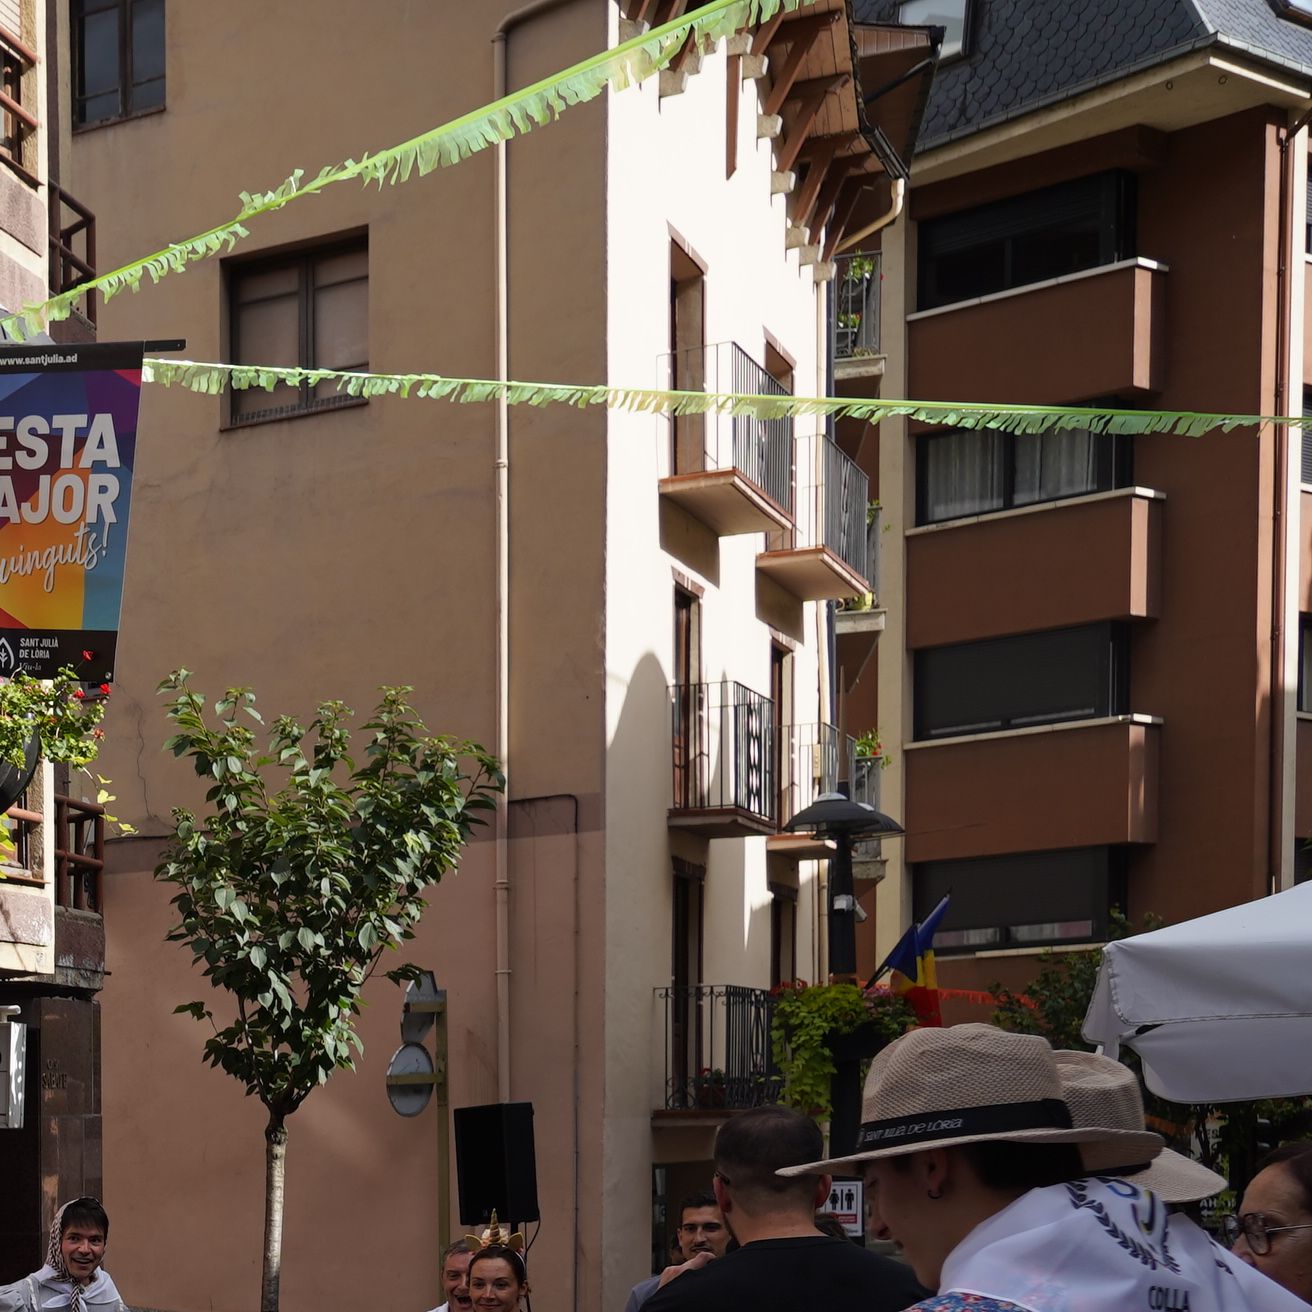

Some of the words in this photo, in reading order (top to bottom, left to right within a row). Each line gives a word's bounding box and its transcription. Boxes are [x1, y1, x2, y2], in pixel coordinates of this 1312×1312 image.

[0, 353, 78, 366] www.santjulia.ad
[19, 637, 39, 648] SANT
[19, 649, 29, 659] DE
